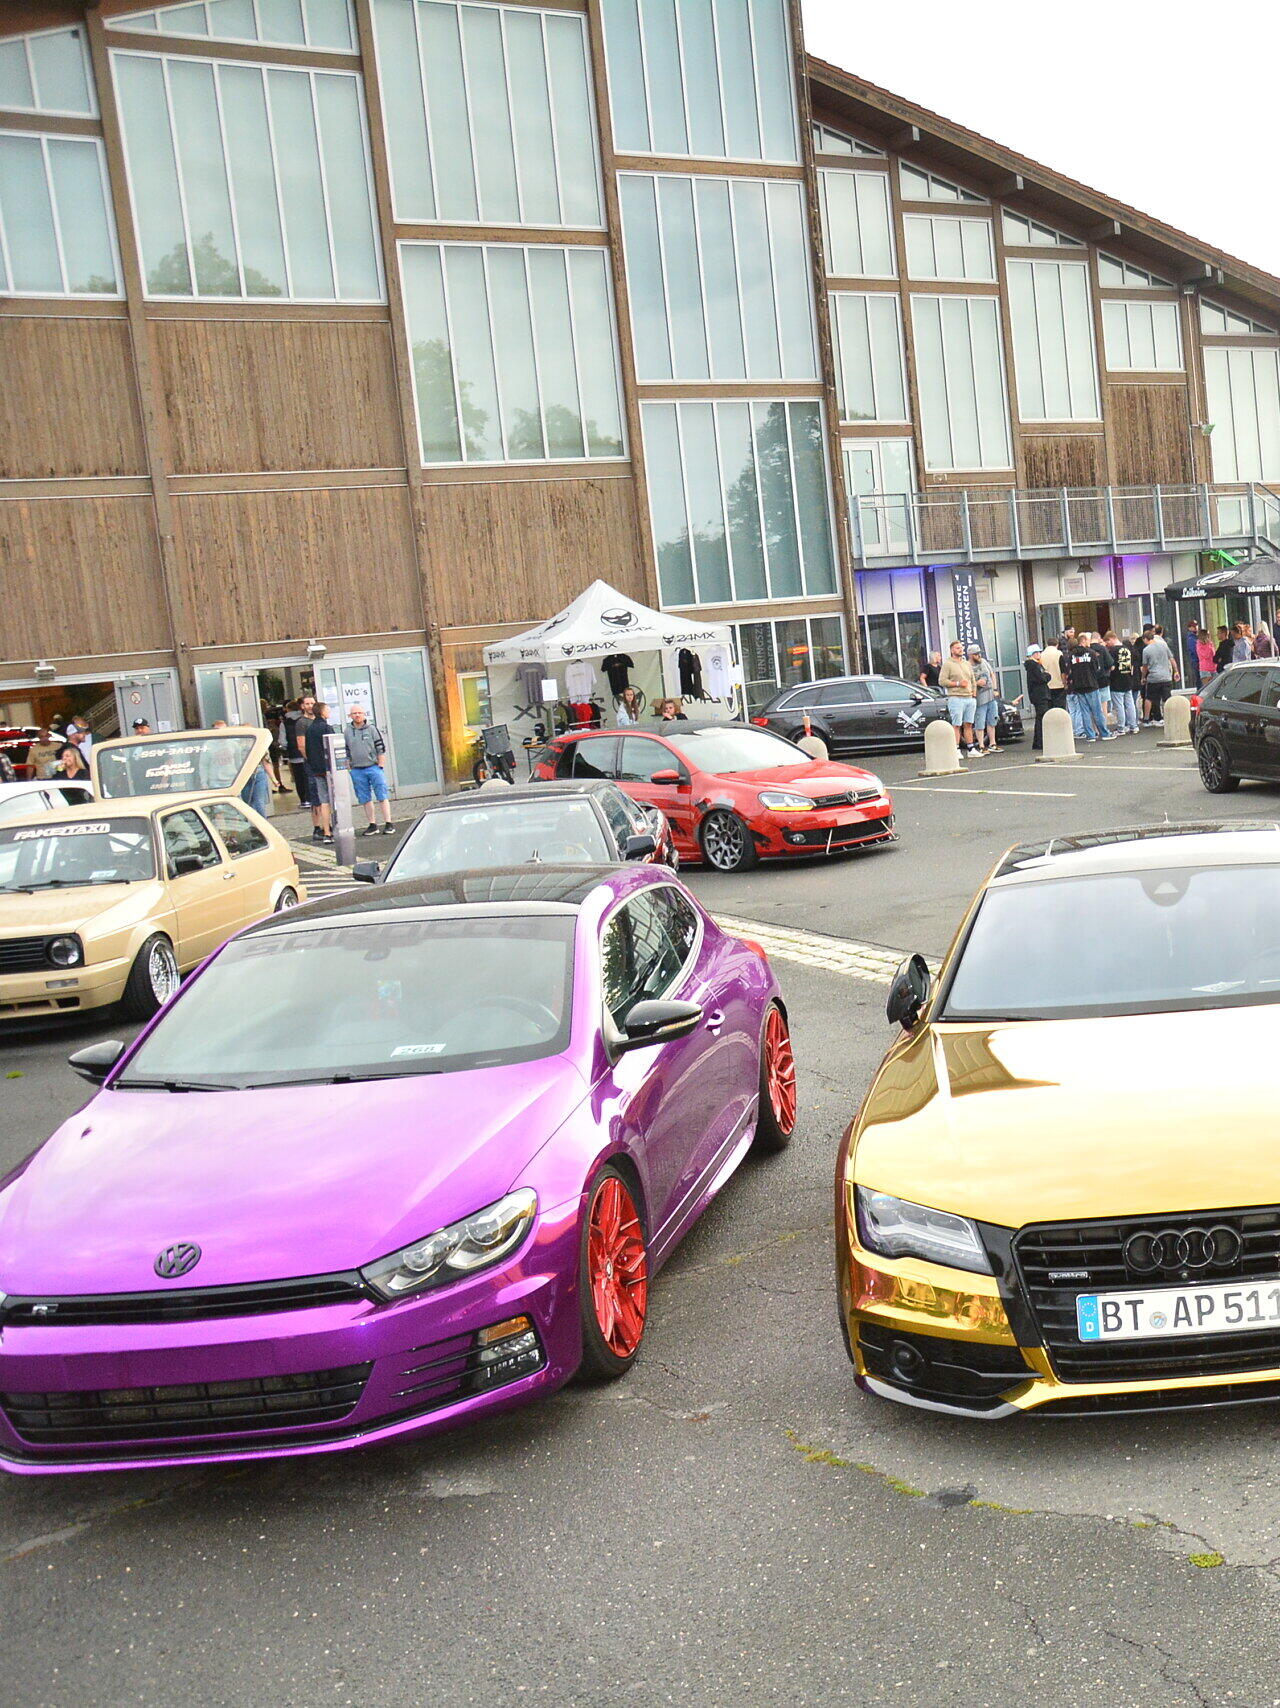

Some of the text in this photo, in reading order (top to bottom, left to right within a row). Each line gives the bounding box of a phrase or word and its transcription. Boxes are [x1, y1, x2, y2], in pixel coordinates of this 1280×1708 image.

[677, 631, 717, 643] 24MX
[576, 640, 618, 653] 24MX
[1102, 1299, 1144, 1332] BT
[1173, 1294, 1215, 1328] AP
[1085, 1321, 1094, 1332] D
